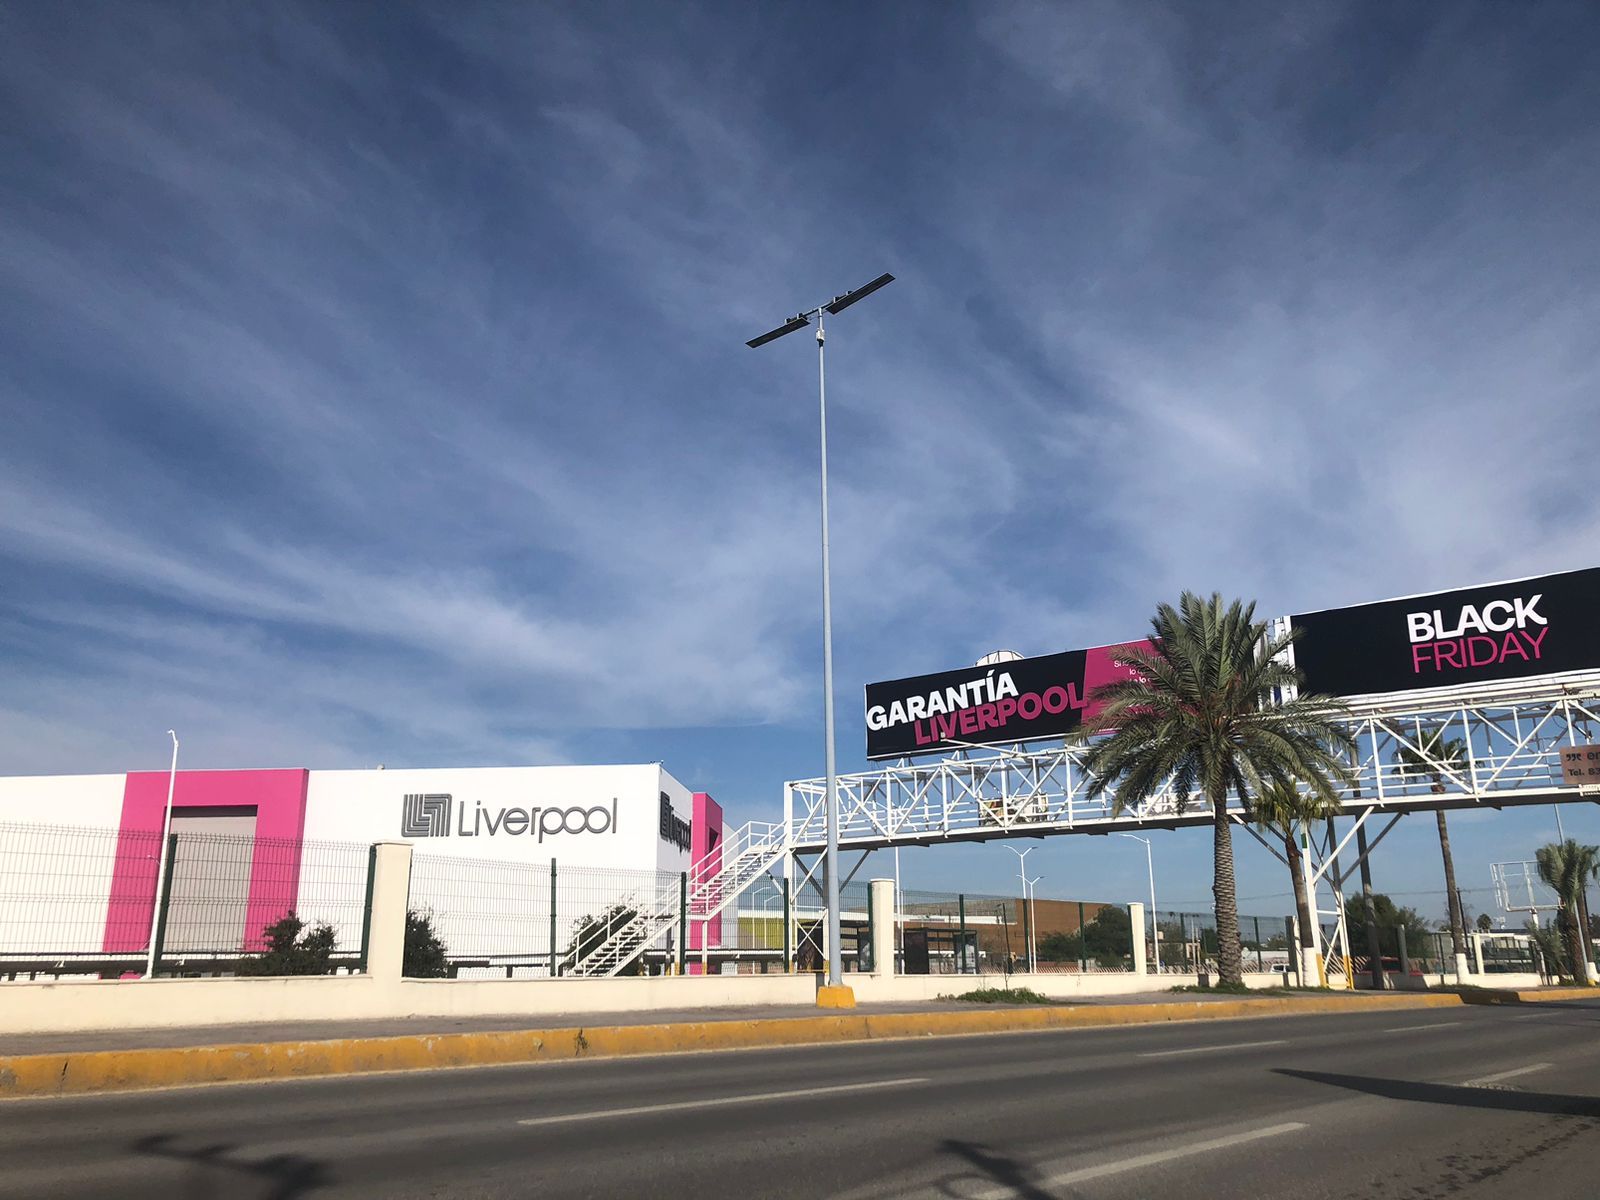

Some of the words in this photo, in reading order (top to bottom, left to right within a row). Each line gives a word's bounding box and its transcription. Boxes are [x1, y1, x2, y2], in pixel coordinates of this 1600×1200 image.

[1406, 594, 1548, 643] BLACK
[1412, 627, 1549, 673] FRIDAY
[866, 669, 1019, 731] GARANTÍA
[914, 682, 1089, 746] LIVERPOOL
[1568, 768, 1585, 776] Tel.
[458, 797, 618, 844] Liverpool
